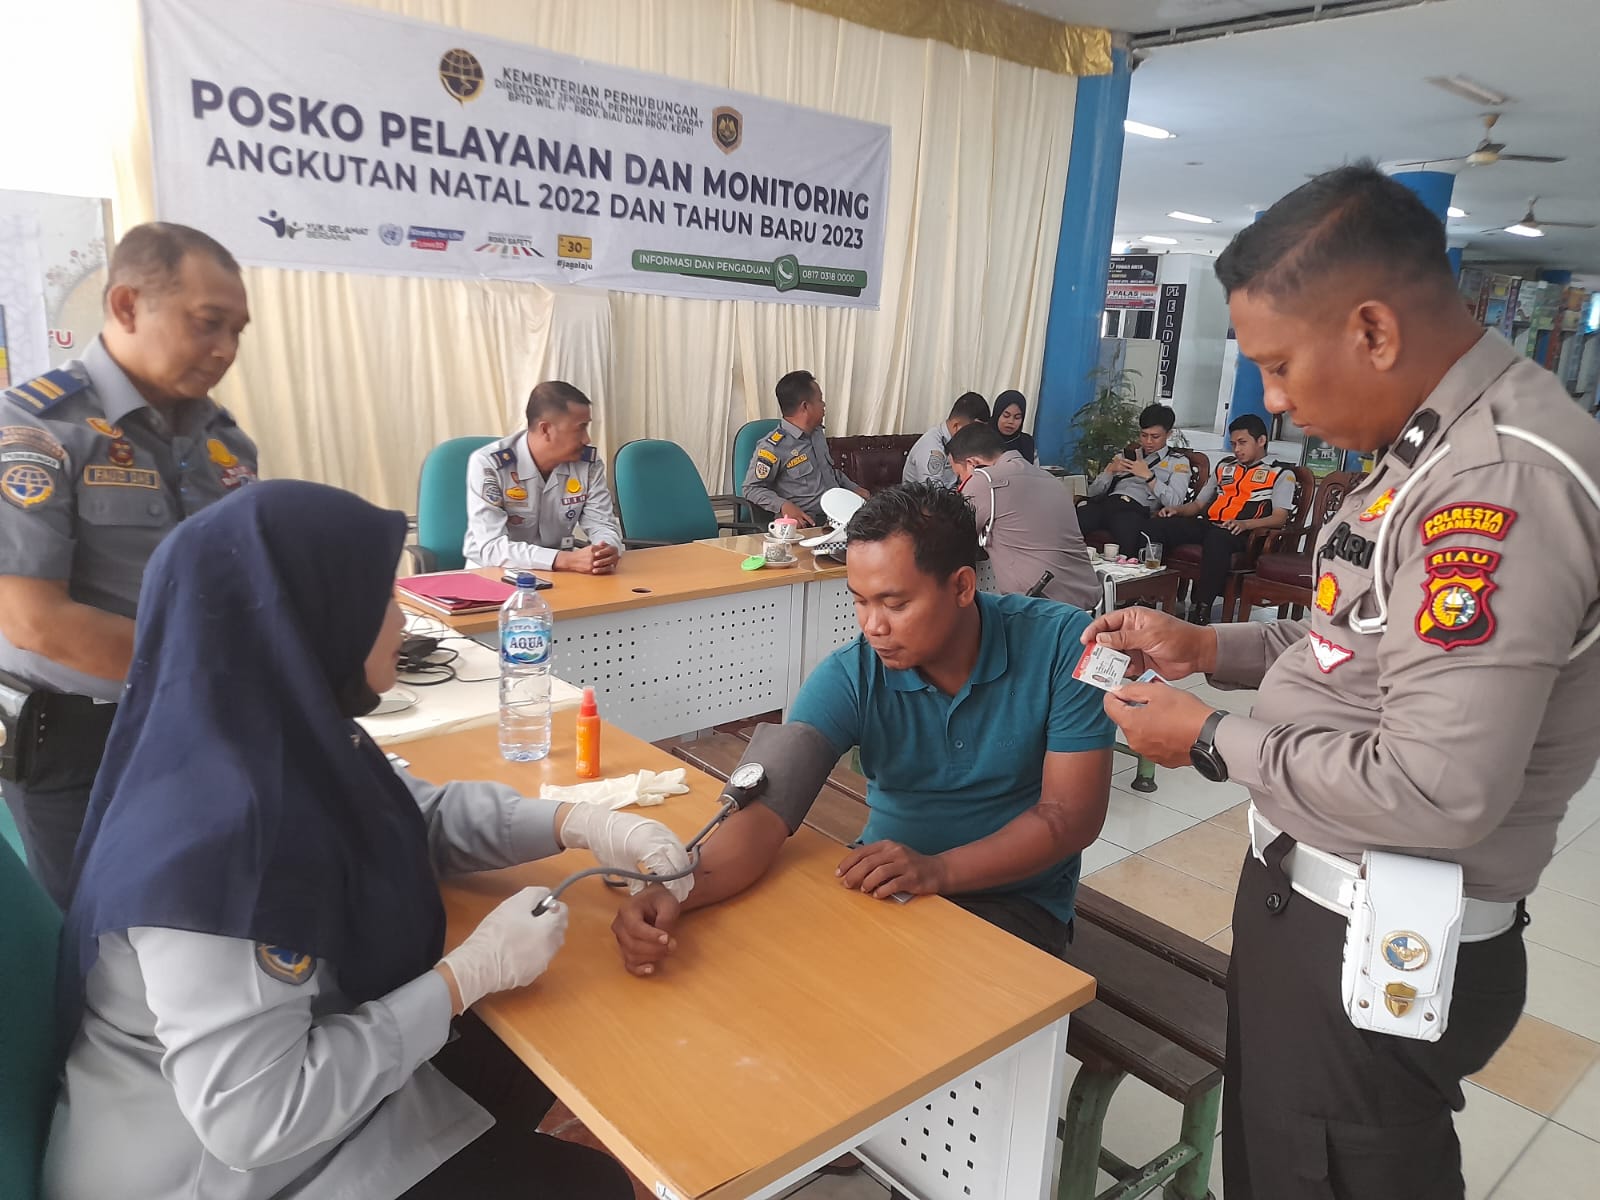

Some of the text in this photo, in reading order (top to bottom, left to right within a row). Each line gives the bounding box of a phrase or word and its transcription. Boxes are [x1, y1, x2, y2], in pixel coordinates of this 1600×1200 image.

[495, 79, 704, 128] DIREKTORAT JENDERAL PERHUBUNGAN DARAT
[503, 67, 698, 118] KEMENTERIAN PERHUBUNGAN
[508, 92, 532, 105] BPTD
[603, 111, 622, 122] RIAU
[625, 115, 642, 126] DAN
[671, 125, 694, 136] KEPRI
[191, 79, 869, 220] POSKO PELAYANAN DAN MONITORING
[207, 137, 864, 250] ANGKUTAN NATAL 2022 DAN TAHUN BARU 2023
[567, 241, 583, 254] 30
[557, 260, 593, 270] #jagalaju
[639, 254, 771, 275] INFORMASI DAN PENGADUAN
[802, 269, 819, 280] 0817
[837, 273, 856, 283] 0000
[1425, 508, 1504, 532] POLRESTA
[1432, 551, 1489, 565] RIAU
[510, 635, 544, 650] AQUA
